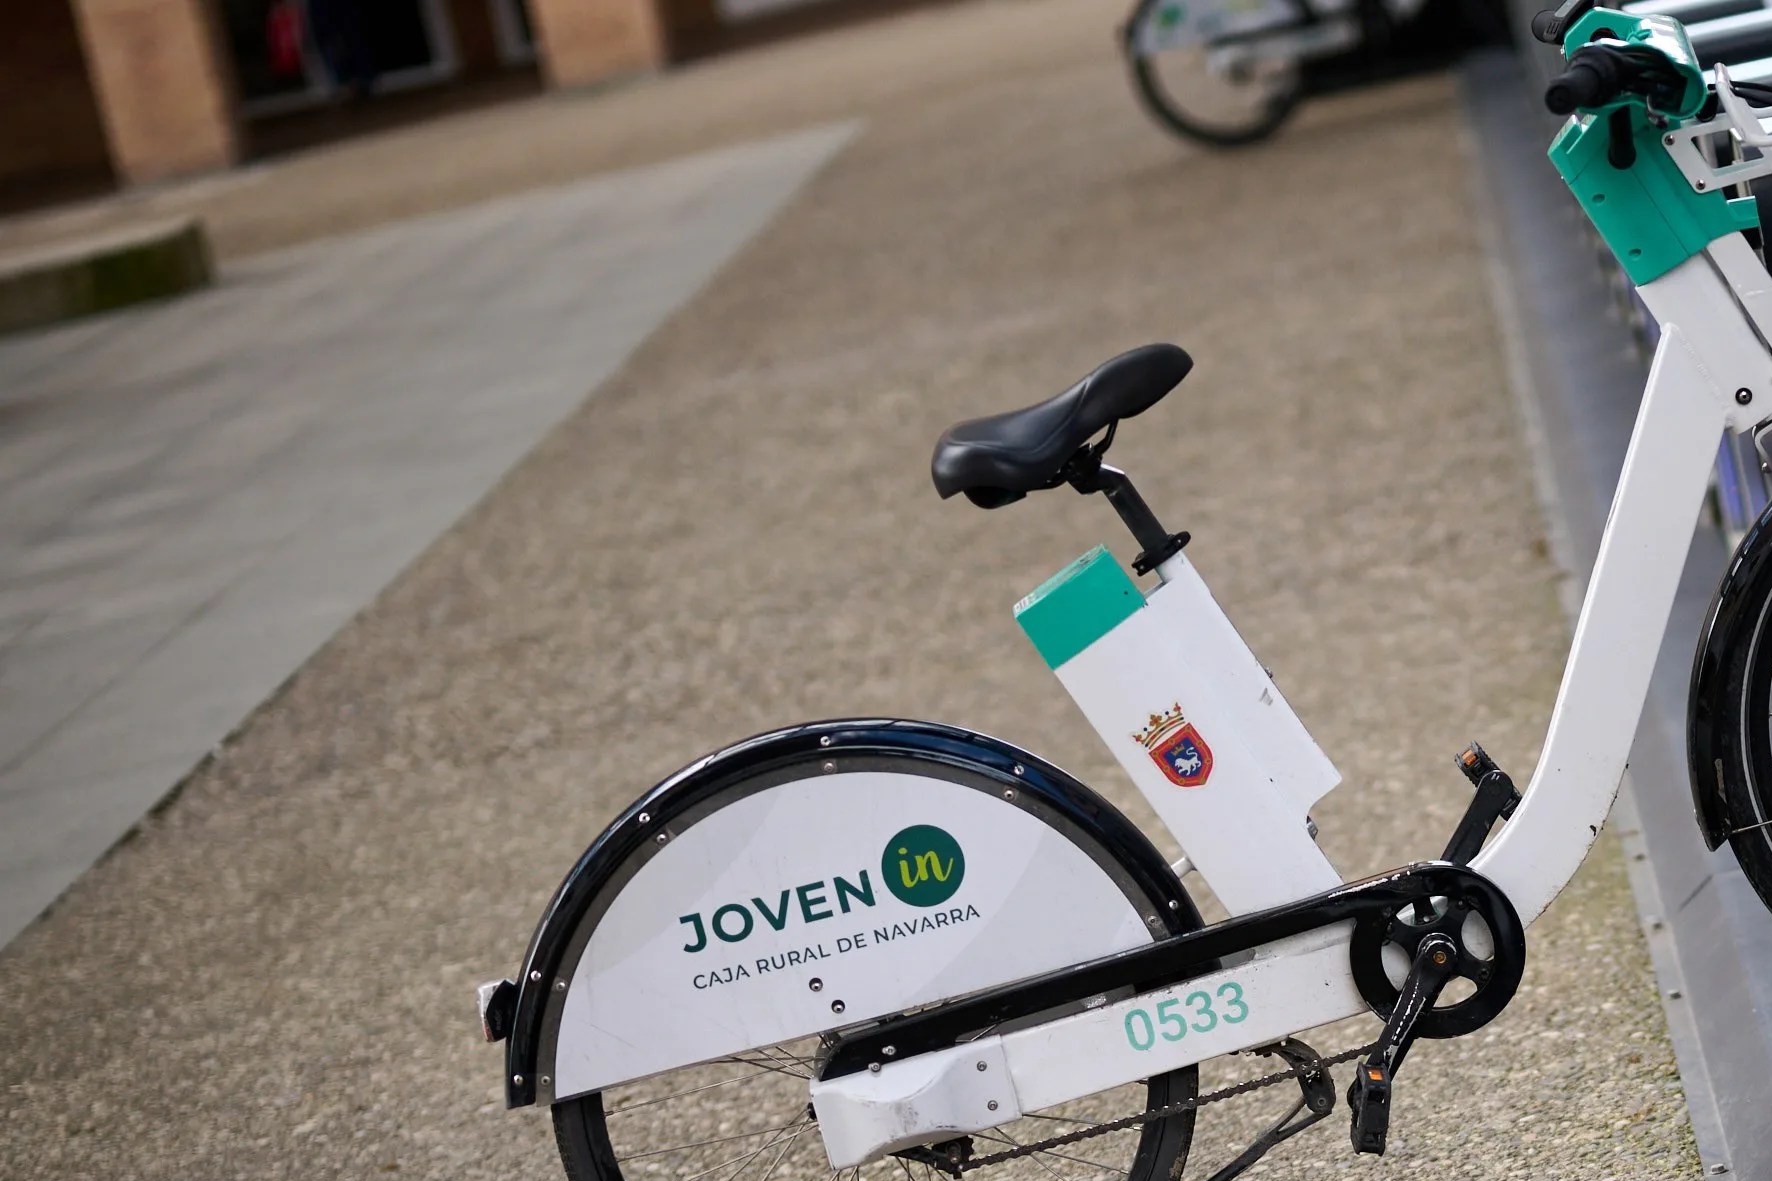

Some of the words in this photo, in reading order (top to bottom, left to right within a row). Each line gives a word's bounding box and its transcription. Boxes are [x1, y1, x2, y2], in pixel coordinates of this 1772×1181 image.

[679, 869, 877, 953] JOVEN
[898, 847, 954, 889] in
[692, 964, 751, 990] CAJA
[755, 943, 831, 974] RURAL
[836, 932, 868, 954] DE
[873, 903, 981, 944] NAVARRA
[1125, 981, 1249, 1051] 0533
